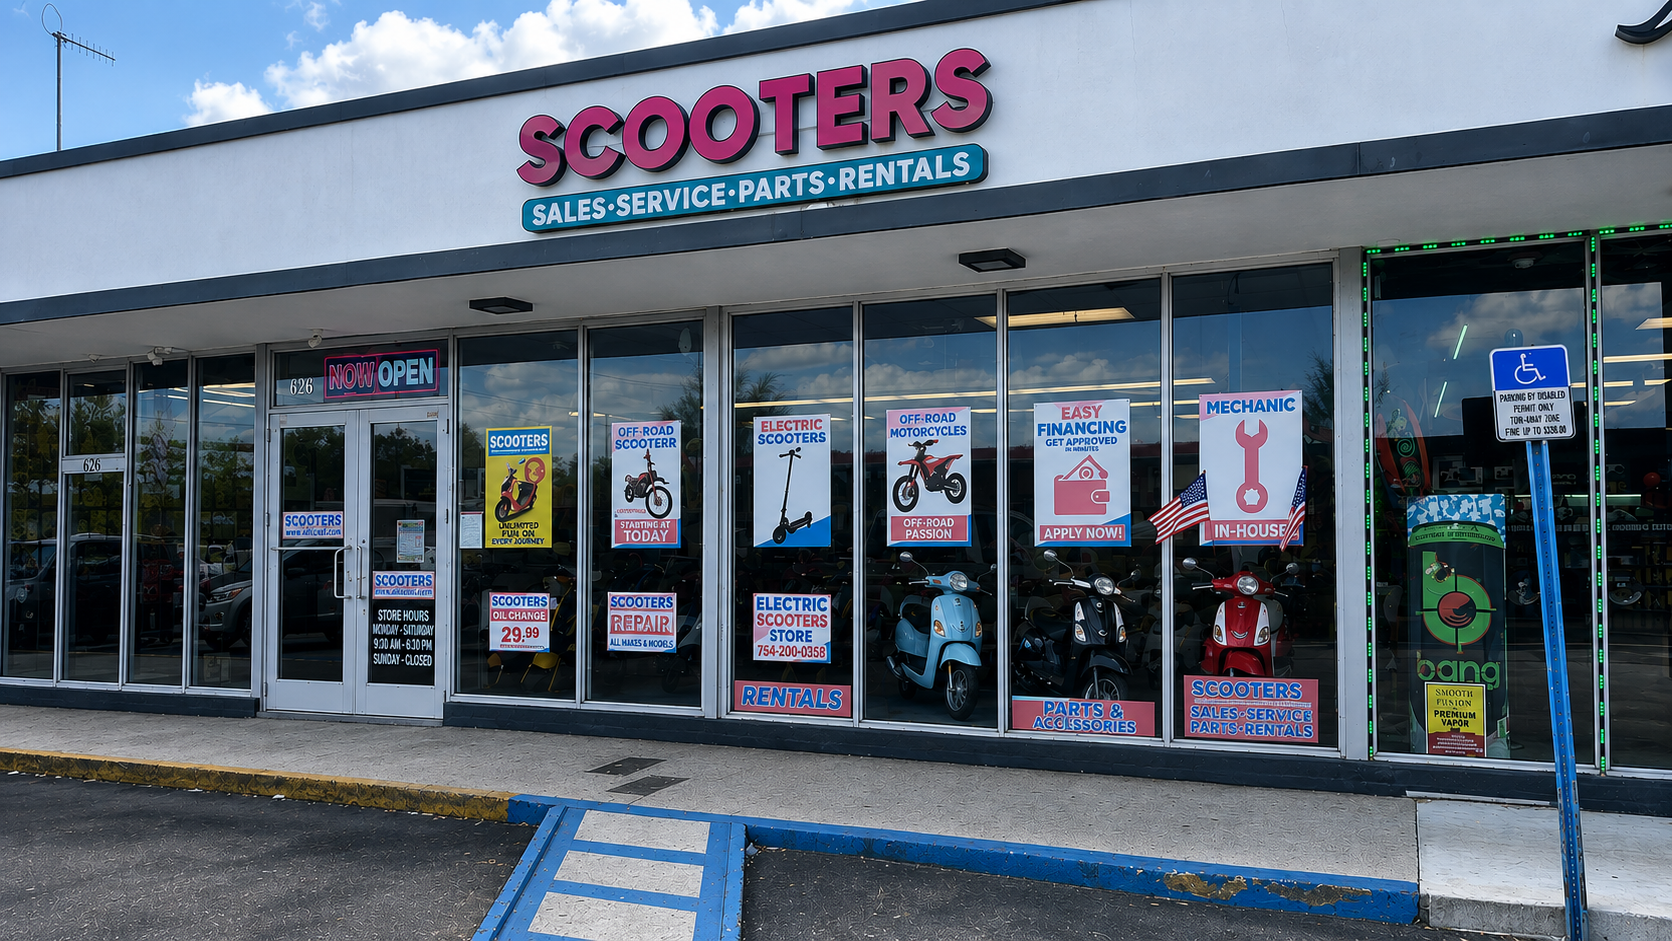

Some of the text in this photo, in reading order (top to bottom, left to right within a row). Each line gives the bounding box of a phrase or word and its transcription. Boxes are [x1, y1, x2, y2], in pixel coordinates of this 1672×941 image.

[516, 47, 993, 187] SCOOTERS
[329, 357, 433, 390] NOW OPEN
[290, 378, 313, 395] 626
[1500, 393, 1526, 402] PARKING
[1528, 392, 1535, 401] BY
[1206, 397, 1295, 414] MECHANIC
[1514, 403, 1554, 413] PERMIT ONLY
[900, 412, 956, 424] OFF-ROAD
[1062, 405, 1102, 420] EASY
[618, 425, 674, 438] OFF-ROAD
[761, 418, 823, 432] ELECTRIC
[1038, 420, 1126, 436] FINANCING
[1505, 428, 1520, 436] FINE
[1523, 427, 1530, 435] UP
[1533, 426, 1541, 435] TO
[758, 432, 826, 445] SCOOTERS
[890, 426, 966, 438] MOTORCYCLES
[490, 434, 548, 448] SCOOTERS
[615, 438, 676, 450] SCOOTERR
[1046, 437, 1118, 446] GET APPROVED
[83, 458, 101, 472] 626
[285, 514, 342, 526] SCOOTERS
[903, 518, 954, 528] OFF-ROAD
[624, 530, 668, 542] TODAY
[906, 528, 952, 539] PASSION
[1044, 526, 1122, 540] APPLY NOW!
[1214, 523, 1288, 538] IN-HOUSE
[376, 574, 432, 586] SCOOTERS
[492, 596, 548, 606] SCOOTERS
[611, 596, 673, 608] SCOOTERS
[756, 597, 827, 612] ELECTRIC
[378, 609, 429, 622] STORE HOURS
[493, 611, 546, 620] OIL CHANGE
[757, 613, 828, 628] SCOOTERS
[373, 624, 399, 635] MONDAY
[611, 614, 672, 633] REPAIR
[610, 638, 620, 646] ALL
[770, 629, 812, 642] STORE
[422, 640, 432, 651] PM
[373, 653, 400, 665] SUNDAY
[405, 654, 432, 666] CLOSED
[1416, 650, 1500, 690] bang
[1192, 680, 1302, 700] SCOOTERS
[1436, 689, 1473, 698] SMOOTH
[741, 685, 842, 710] RENTALS
[1436, 699, 1472, 707] FUSION
[1044, 700, 1124, 719] PARTS &
[1434, 710, 1476, 720] PREMIUM
[1032, 716, 1136, 734] ACCESSORIES
[1441, 719, 1469, 728] VAPOR
